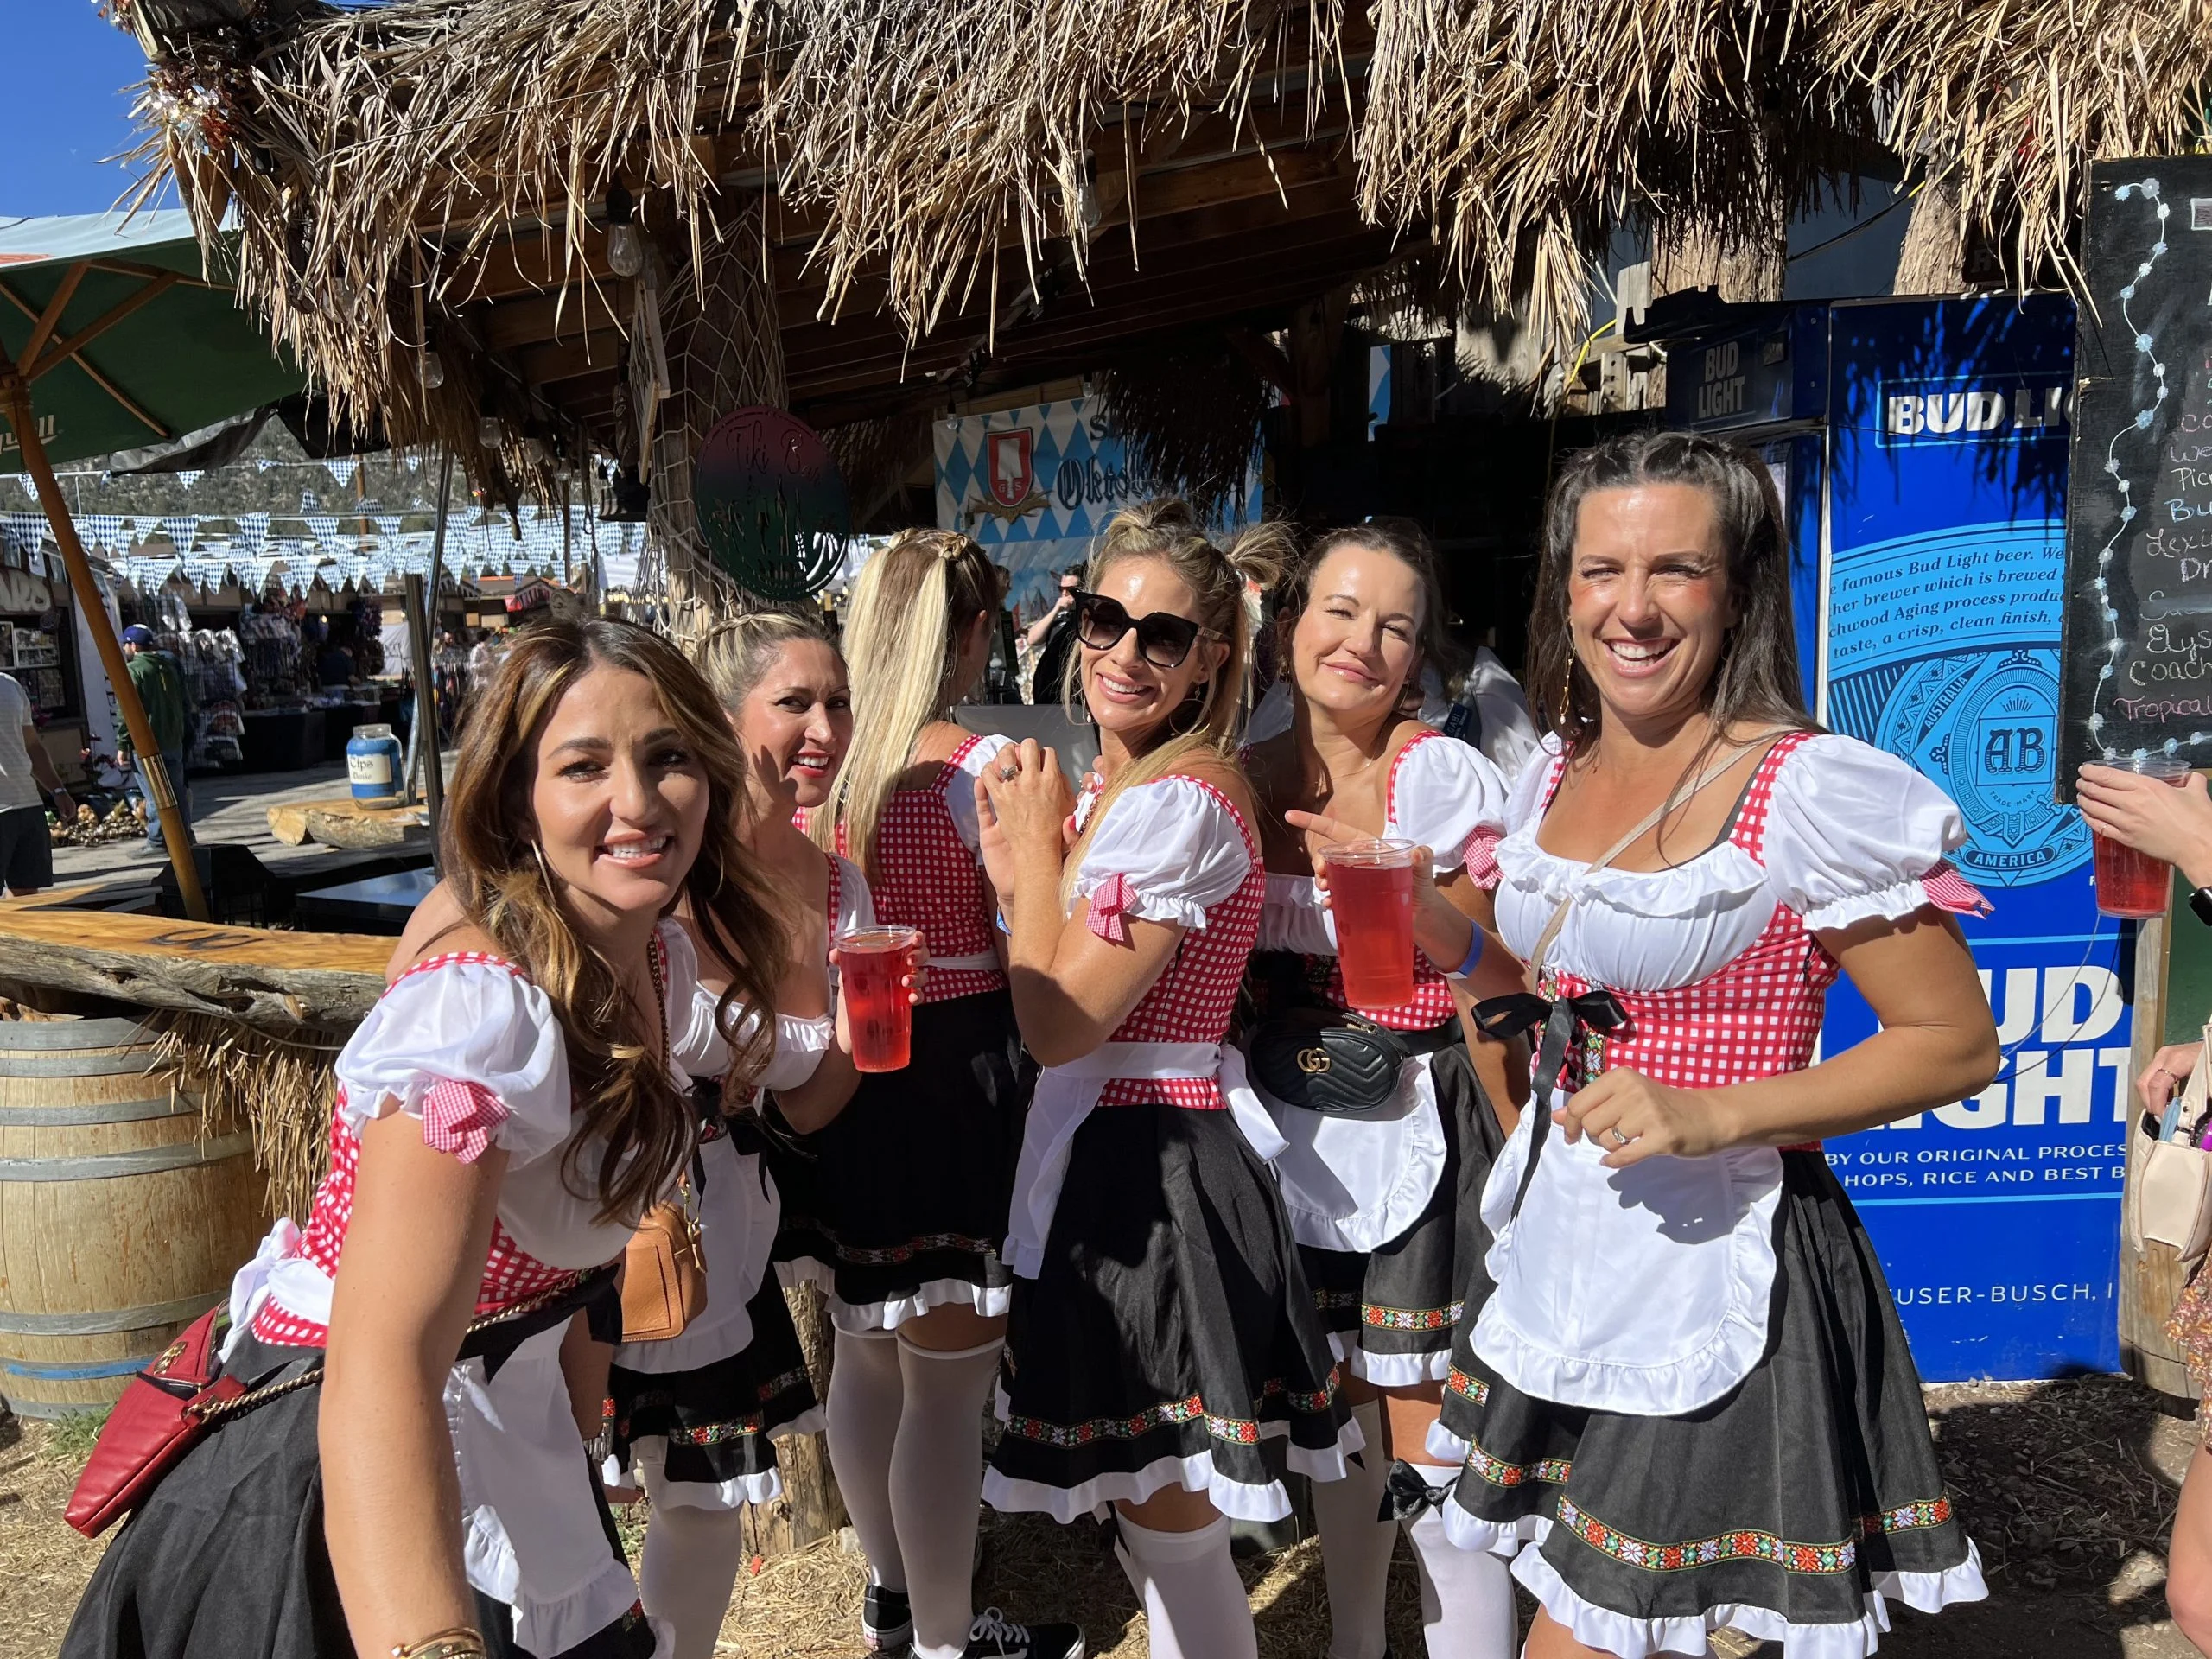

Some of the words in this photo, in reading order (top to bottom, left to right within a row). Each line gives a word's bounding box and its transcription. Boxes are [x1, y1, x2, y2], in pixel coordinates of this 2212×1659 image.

[1705, 341, 1739, 383] BUD
[1698, 375, 1745, 419] LIGHT
[1888, 391, 2006, 436] BUD
[726, 420, 770, 474] Tiki
[1843, 568, 1903, 592] famous
[1909, 556, 1941, 575] Bud
[1947, 552, 1989, 569] Light
[1995, 550, 2033, 563] beer.
[2043, 546, 2063, 560] We
[1829, 601, 1859, 617] her
[1864, 585, 1920, 607] brewer
[1925, 574, 1973, 593] which
[1979, 572, 1993, 585] is
[1998, 568, 2058, 582] brewed
[1829, 610, 1889, 638] chwood
[1894, 601, 1940, 621] Aging
[1943, 594, 2006, 613] process
[1834, 639, 1877, 659] taste,
[1882, 634, 1891, 645] a
[1898, 624, 1944, 640] crisp,
[1950, 616, 1995, 631] clean
[2001, 610, 2052, 625] finish,
[1924, 677, 1968, 729] AUSTRALIA
[2113, 695, 2212, 724] Tropical
[1985, 728, 2046, 774] AB
[1989, 790, 2012, 807] TRADE
[2017, 788, 2037, 806] MARK
[1973, 850, 2047, 868] AMERICA
[1976, 965, 2123, 1046] UD
[1844, 1173, 1913, 1187] HOPS,
[1923, 1171, 1977, 1185] RICE
[1986, 1169, 2034, 1183] AND
[2044, 1166, 2103, 1181] BEST
[1859, 1151, 1909, 1165] OUR
[1917, 1147, 2030, 1163] ORIGINAL
[2038, 1144, 2126, 1160] PROCES
[1891, 1283, 2096, 1306] USER-BUSCH,
